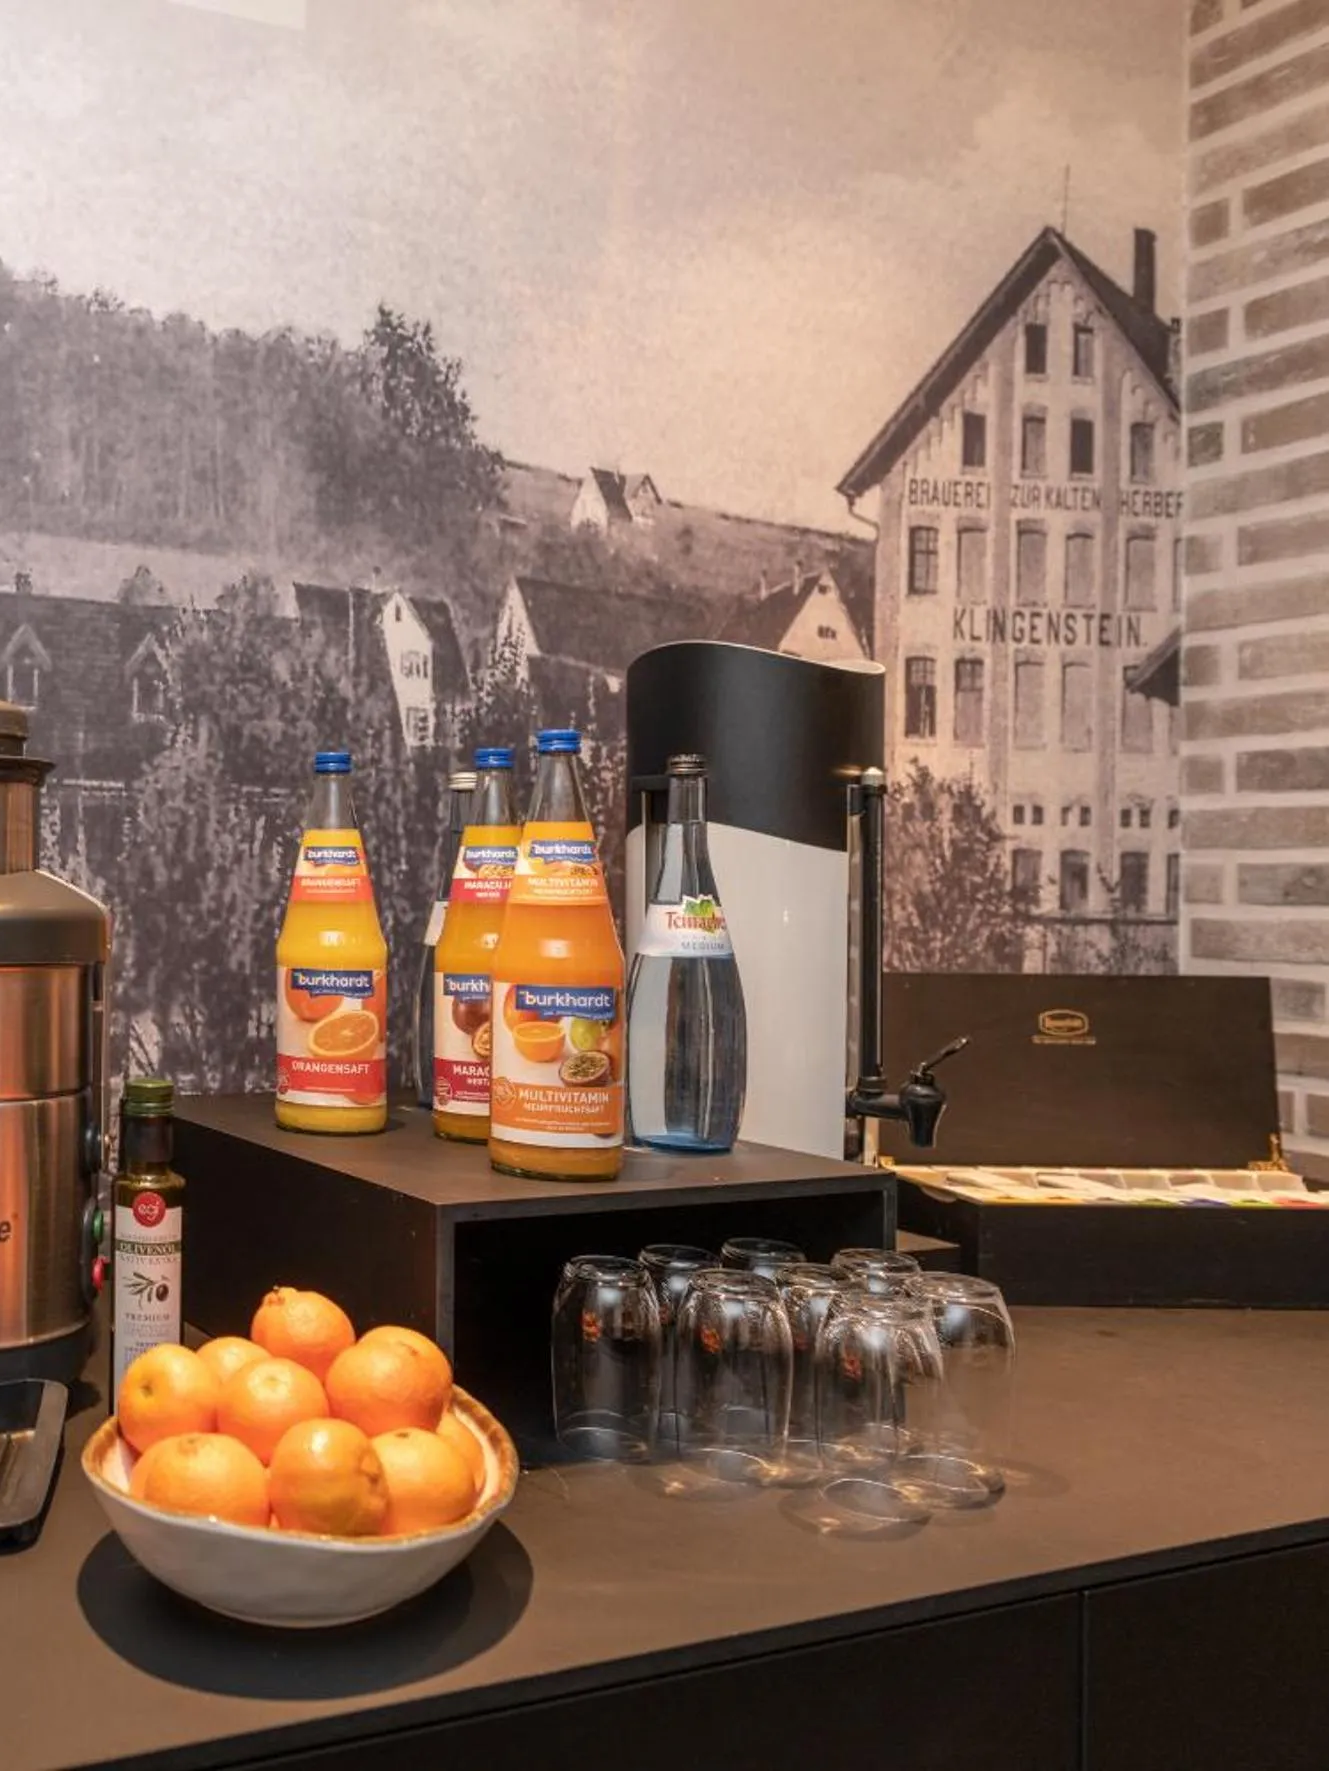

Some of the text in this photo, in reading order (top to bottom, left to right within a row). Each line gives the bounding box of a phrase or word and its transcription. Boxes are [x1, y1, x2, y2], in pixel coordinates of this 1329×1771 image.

[908, 479, 991, 508] BRAUEREI
[1011, 484, 1040, 509] ZUR
[1044, 485, 1101, 512] KALTEN
[306, 850, 357, 859] burkhardt
[298, 974, 370, 988] burkhardt
[448, 978, 490, 993] burkh
[524, 990, 611, 1008] burkhardt
[291, 1060, 371, 1074] ORANGENSAFT
[452, 1063, 490, 1077] MARAC
[518, 1087, 610, 1104] MULTIVITAMIN
